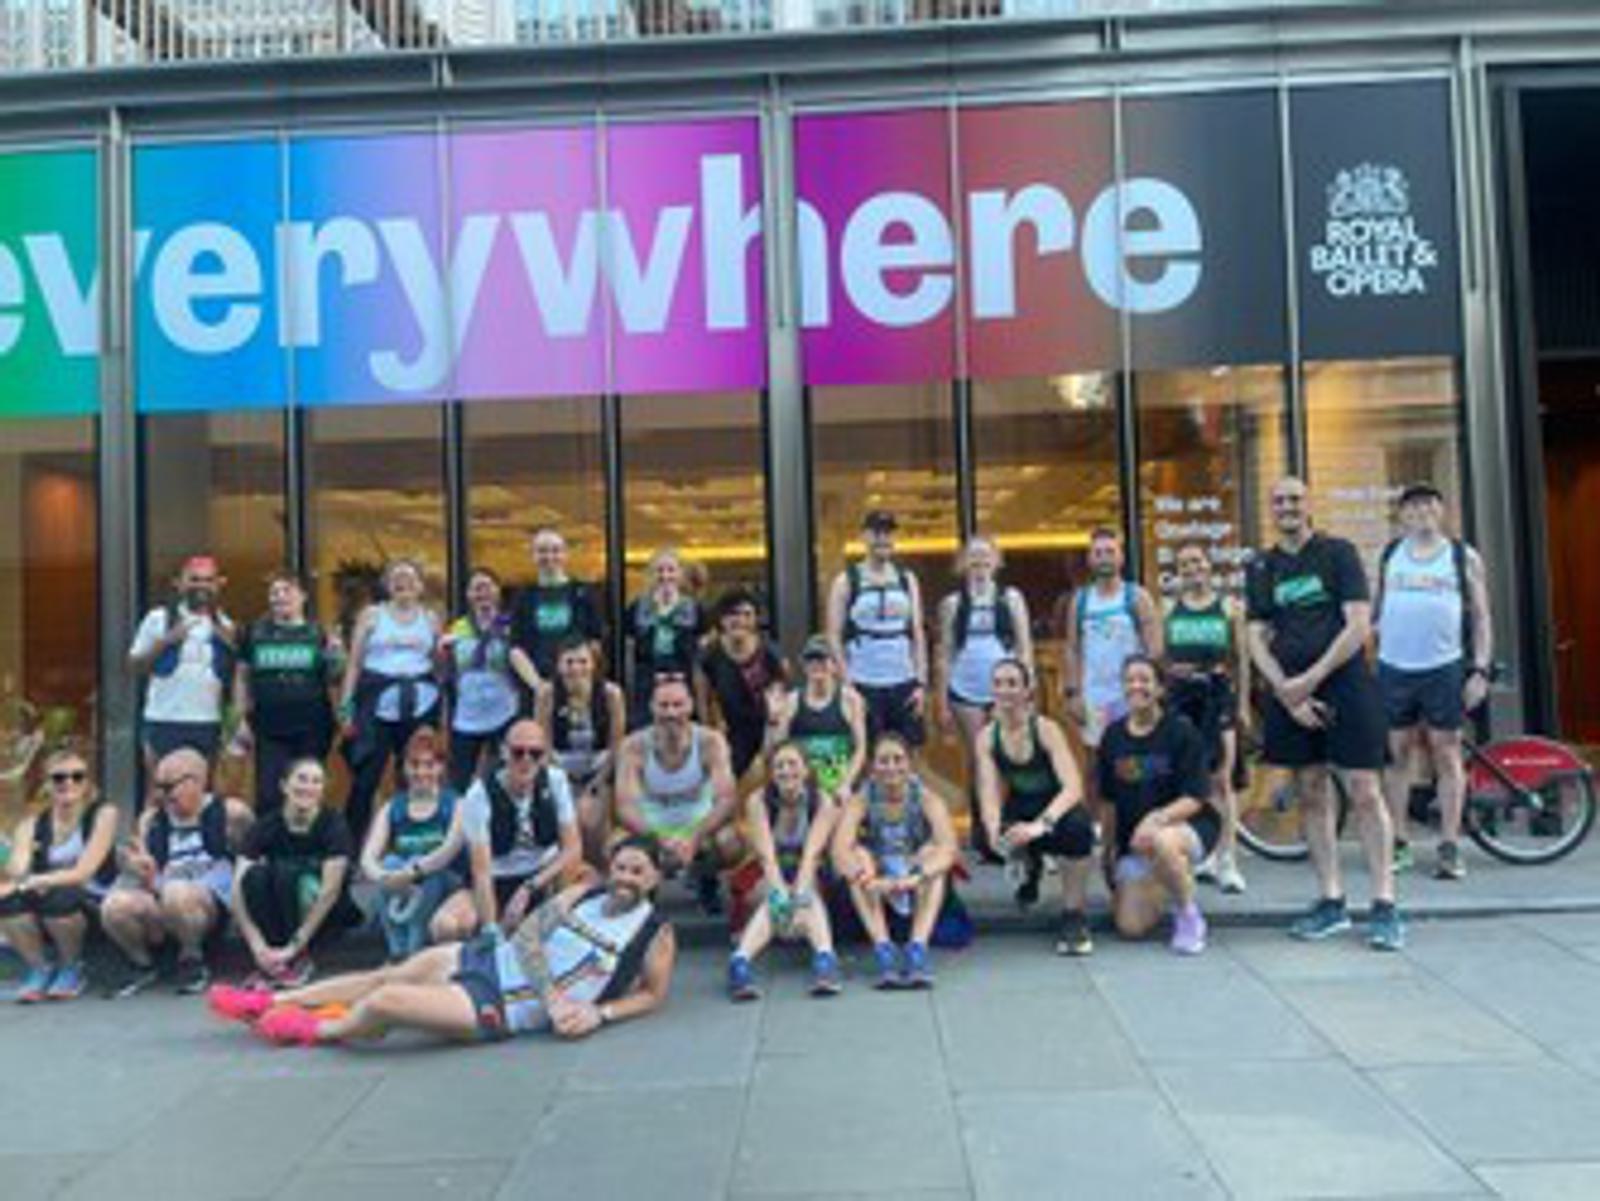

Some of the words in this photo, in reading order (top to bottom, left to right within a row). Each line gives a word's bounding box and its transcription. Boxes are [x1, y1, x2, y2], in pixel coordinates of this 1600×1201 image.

[1326, 216, 1419, 246] ROYAL
[1310, 244, 1405, 272] BALLET
[1412, 240, 1438, 266] &
[1326, 268, 1425, 295] OPERA
